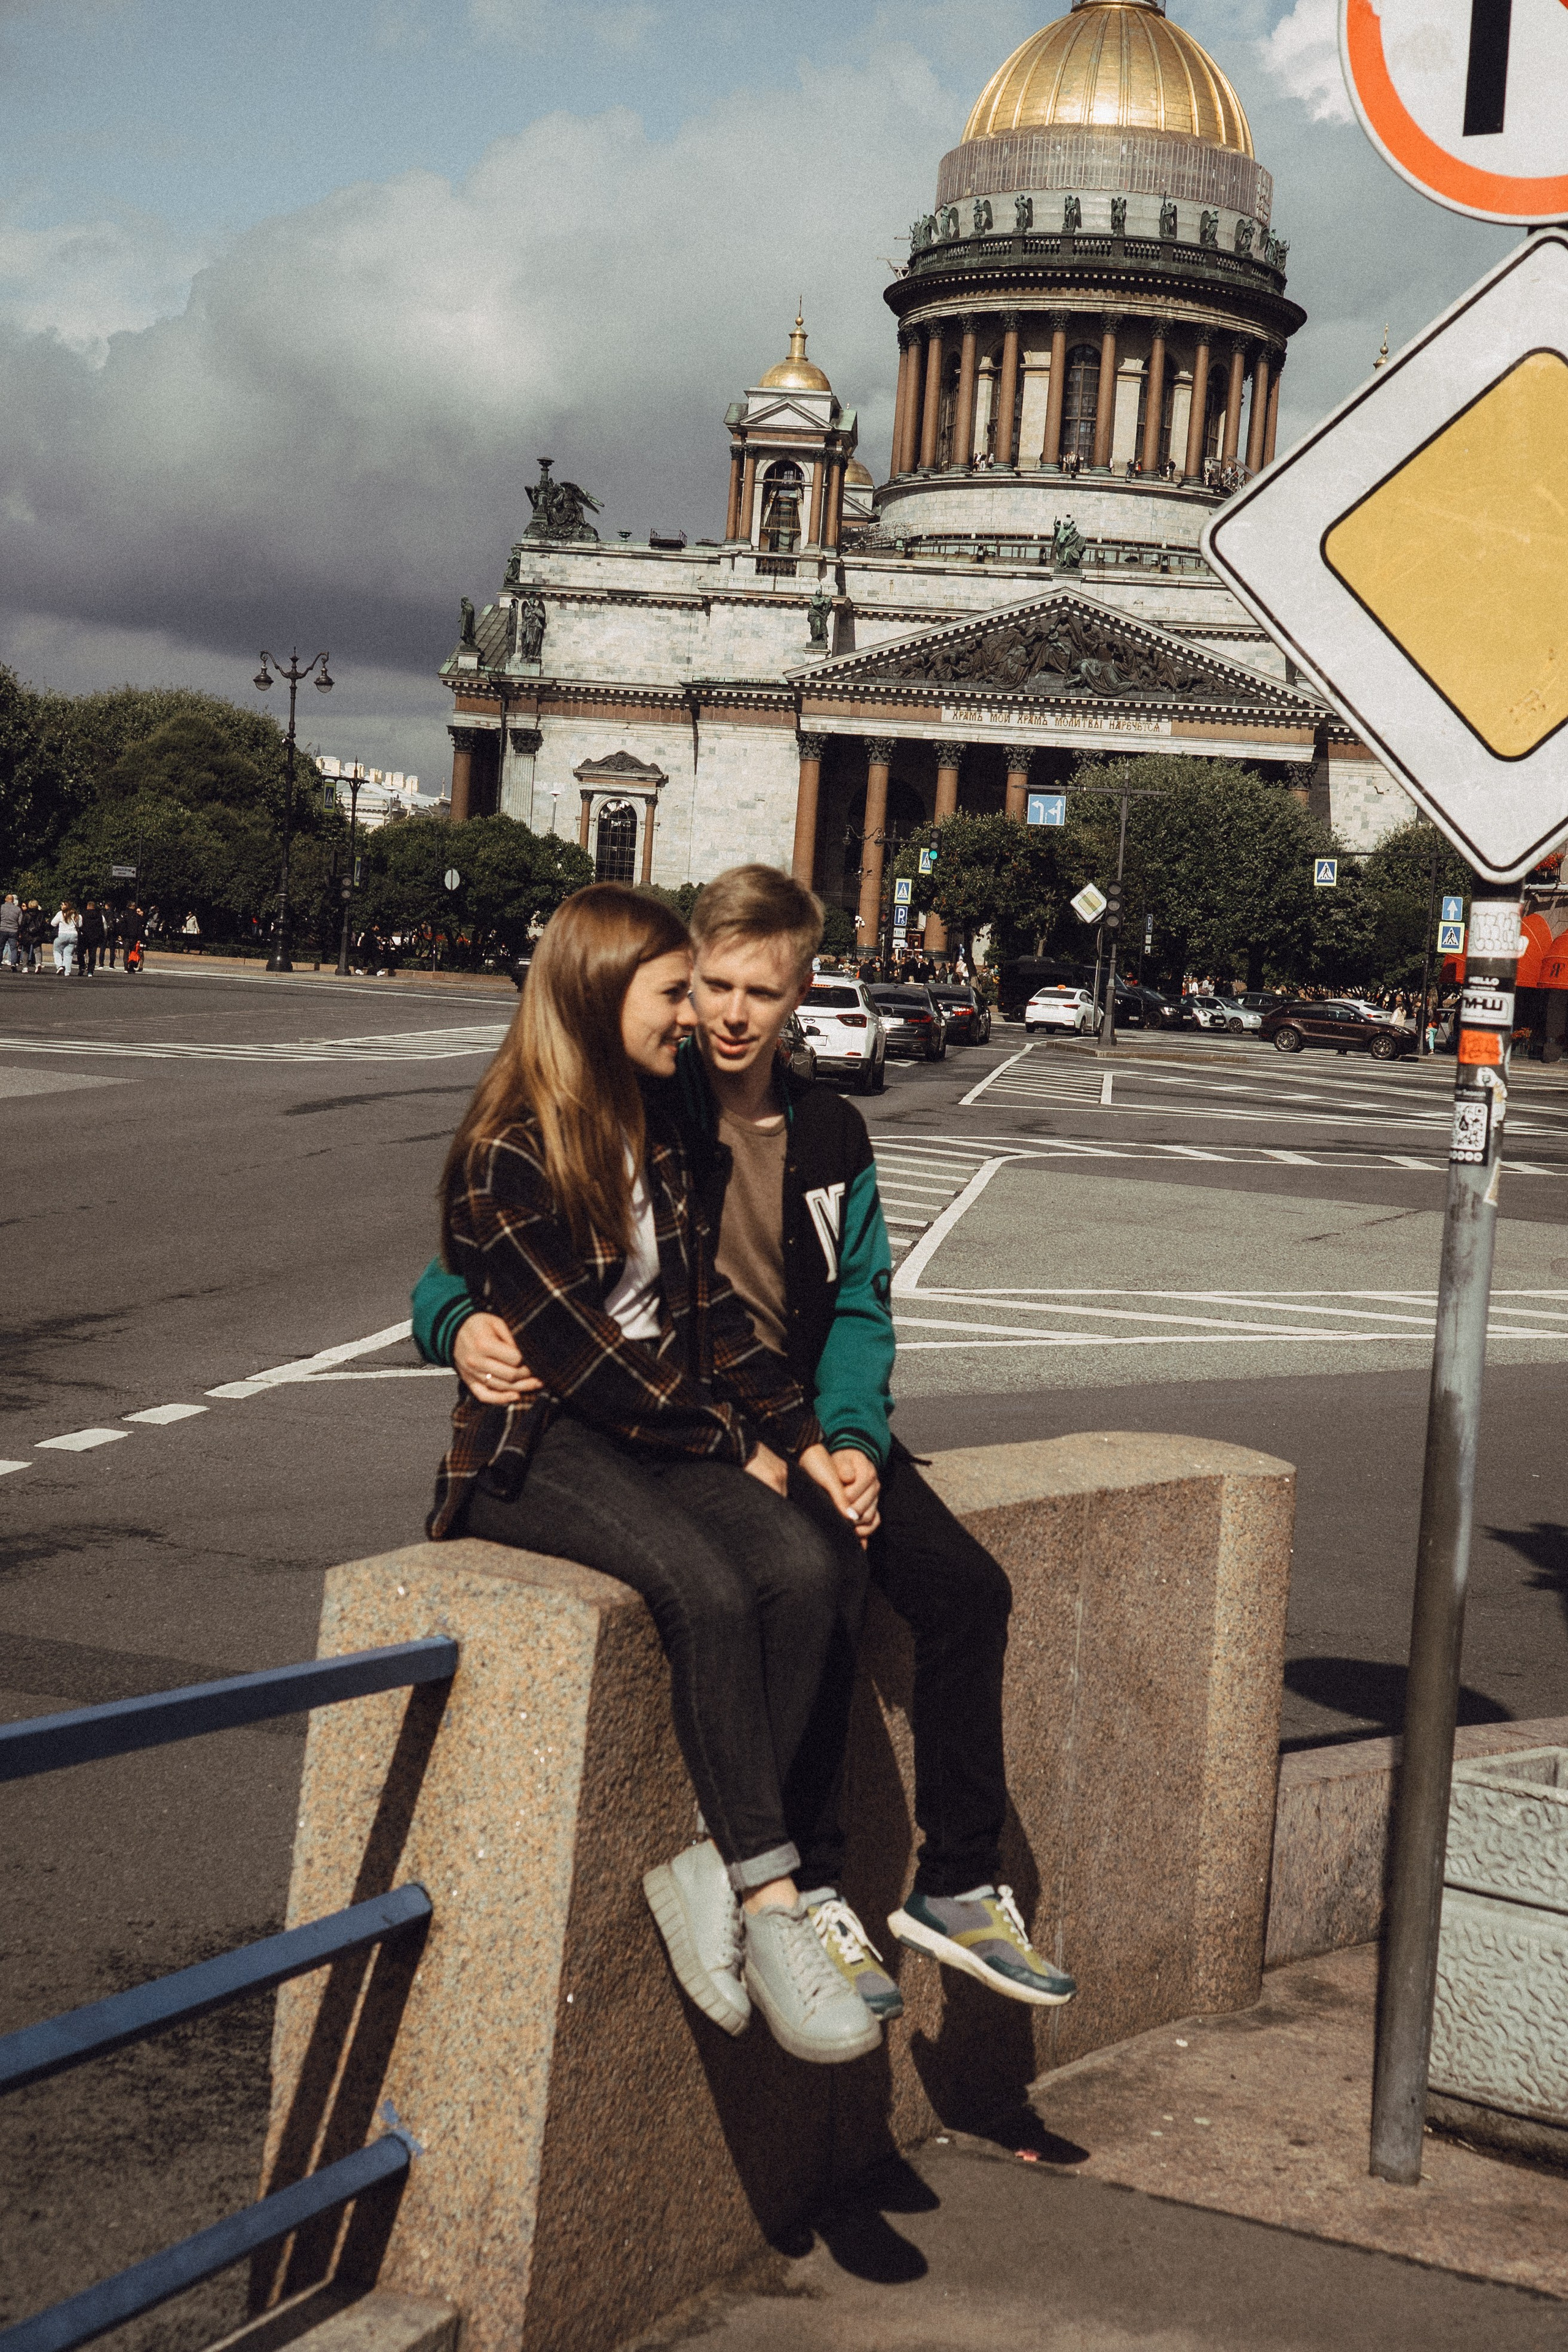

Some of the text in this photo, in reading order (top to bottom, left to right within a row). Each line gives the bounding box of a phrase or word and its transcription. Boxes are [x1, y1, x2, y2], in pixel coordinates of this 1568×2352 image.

[952, 710, 983, 722] ХРАМЪ
[1017, 714, 1048, 725] ХРАМЪ
[1054, 717, 1102, 729] МОЛИТВЫ
[897, 908, 905, 924] P
